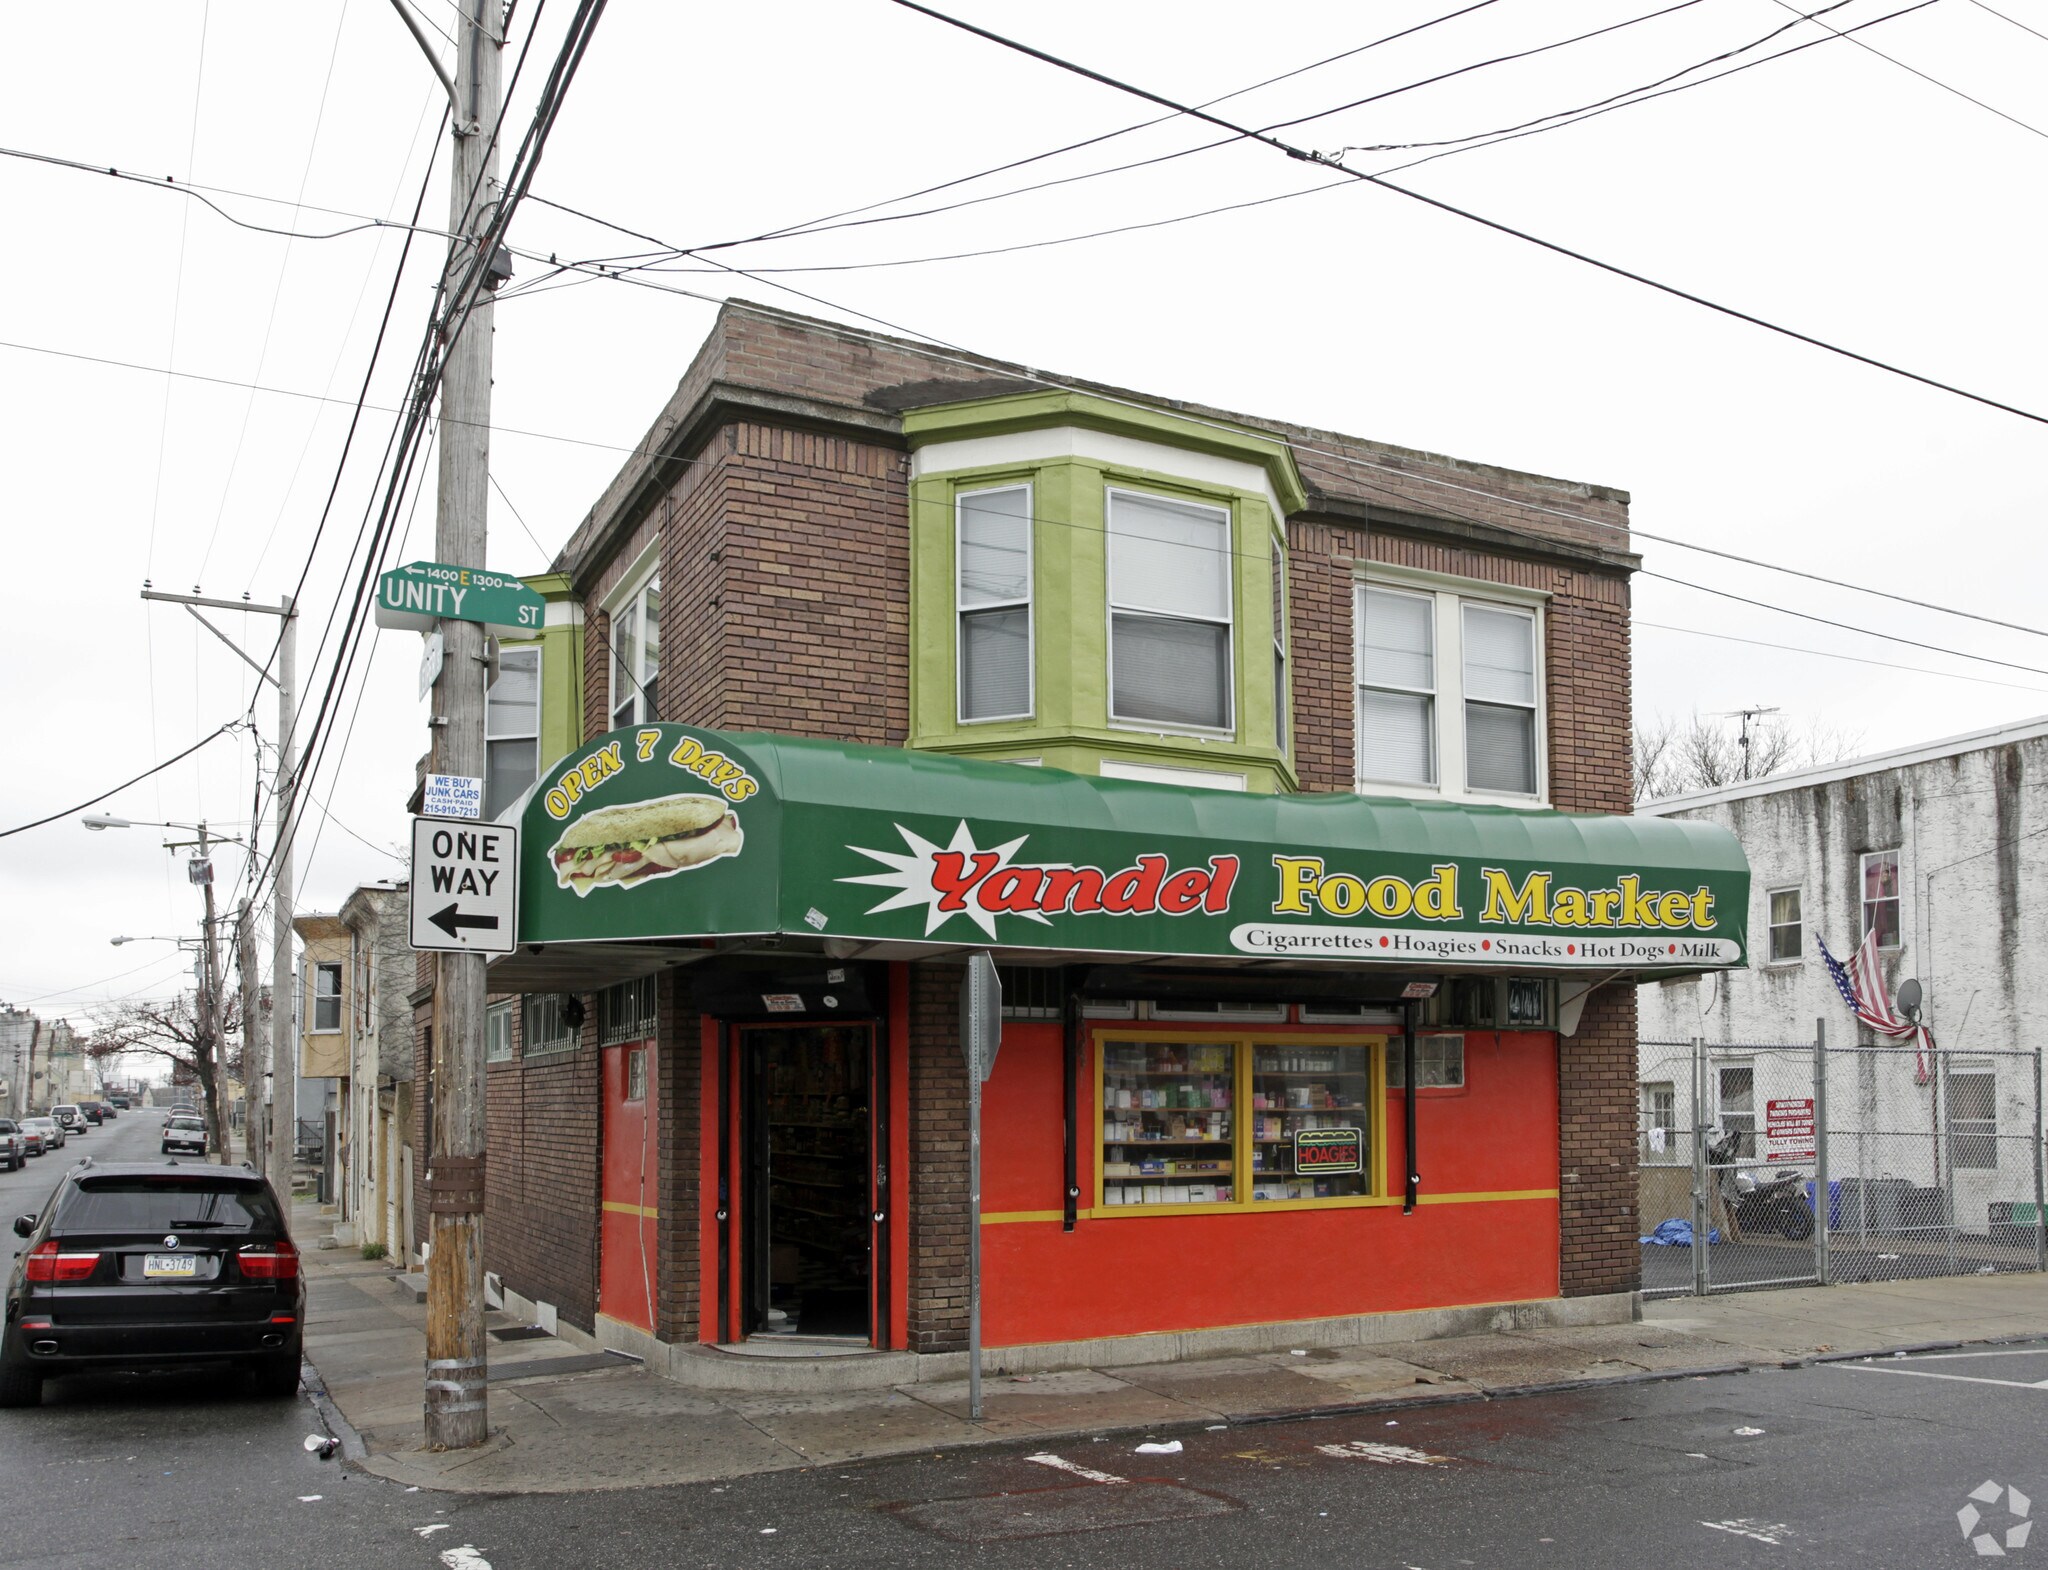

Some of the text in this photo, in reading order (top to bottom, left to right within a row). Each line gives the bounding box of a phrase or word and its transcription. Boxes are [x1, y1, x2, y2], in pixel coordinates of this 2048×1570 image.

[427, 567, 503, 588] 1400 E 1300
[386, 577, 539, 625] UNITY ST
[435, 776, 472, 788] WE BUY
[545, 729, 758, 819] OPEN 7 DAYS
[426, 787, 479, 800] JUNK CARS
[425, 804, 478, 817] 215-910-7213
[432, 830, 499, 862] ONE
[431, 865, 500, 896] WAY
[931, 851, 1239, 914] Yandel
[1272, 855, 1717, 930] Food Market
[1246, 929, 1721, 960] Cigarrettes Hoagies Snacks Hot Dogs Milk
[1298, 1145, 1357, 1163] HOAGIES
